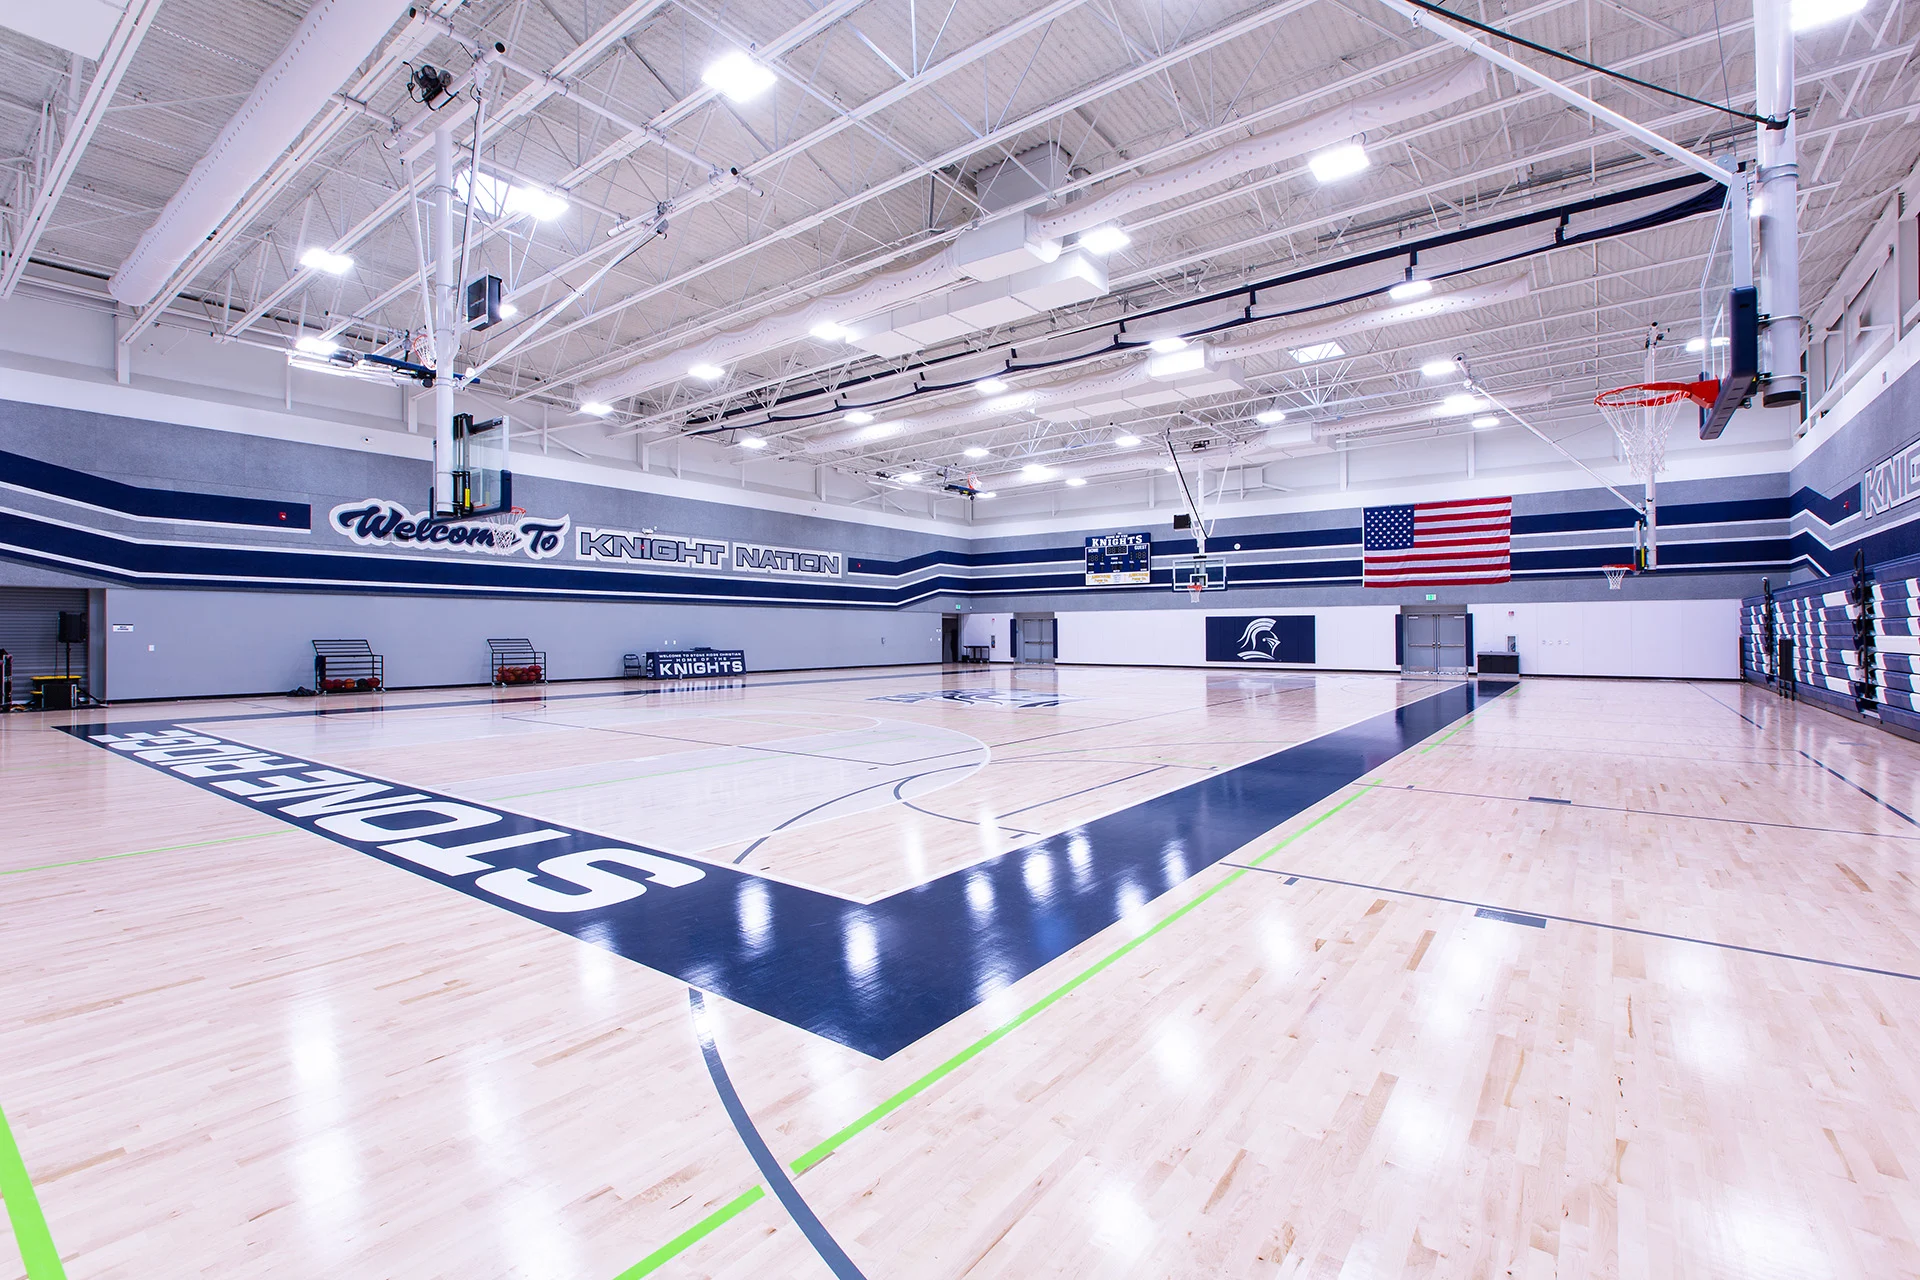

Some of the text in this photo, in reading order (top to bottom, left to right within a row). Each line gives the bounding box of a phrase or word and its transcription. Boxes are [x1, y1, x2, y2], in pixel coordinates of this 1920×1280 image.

[521, 522, 566, 554] To
[1092, 535, 1142, 546] KNIGHTS
[580, 531, 840, 574] KNIGHT NATION
[659, 660, 743, 676] KNIGHTS
